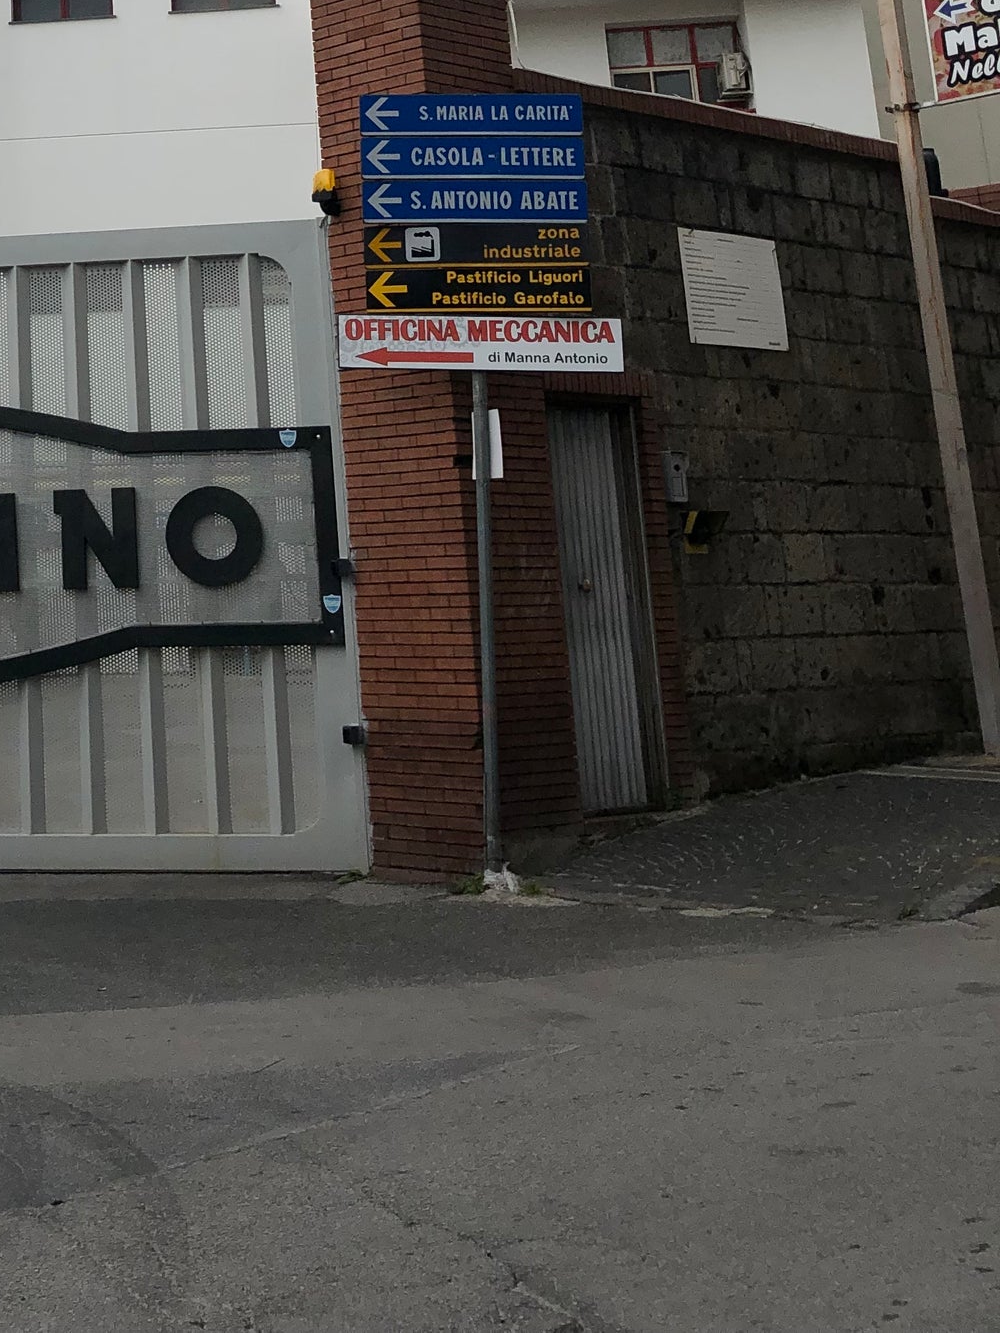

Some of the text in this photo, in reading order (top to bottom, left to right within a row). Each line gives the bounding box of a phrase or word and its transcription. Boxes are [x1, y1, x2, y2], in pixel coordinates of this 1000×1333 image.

[944, 18, 1000, 57] Ma
[436, 106, 484, 121] MARIA
[491, 106, 509, 121] LA
[515, 105, 573, 121] CARITA'
[411, 147, 484, 166] CASOLA
[501, 147, 576, 166] LETTERE
[431, 191, 512, 210] ANTONIO
[520, 191, 579, 210] ABATE
[538, 227, 580, 240] zona
[483, 243, 581, 259] industriale
[446, 269, 583, 286] Pastificio Liguori
[432, 291, 584, 305] Pastificio Garofalo
[344, 318, 616, 344] OFFICINA MECCANICA
[488, 351, 608, 364] di Manna Antonio
